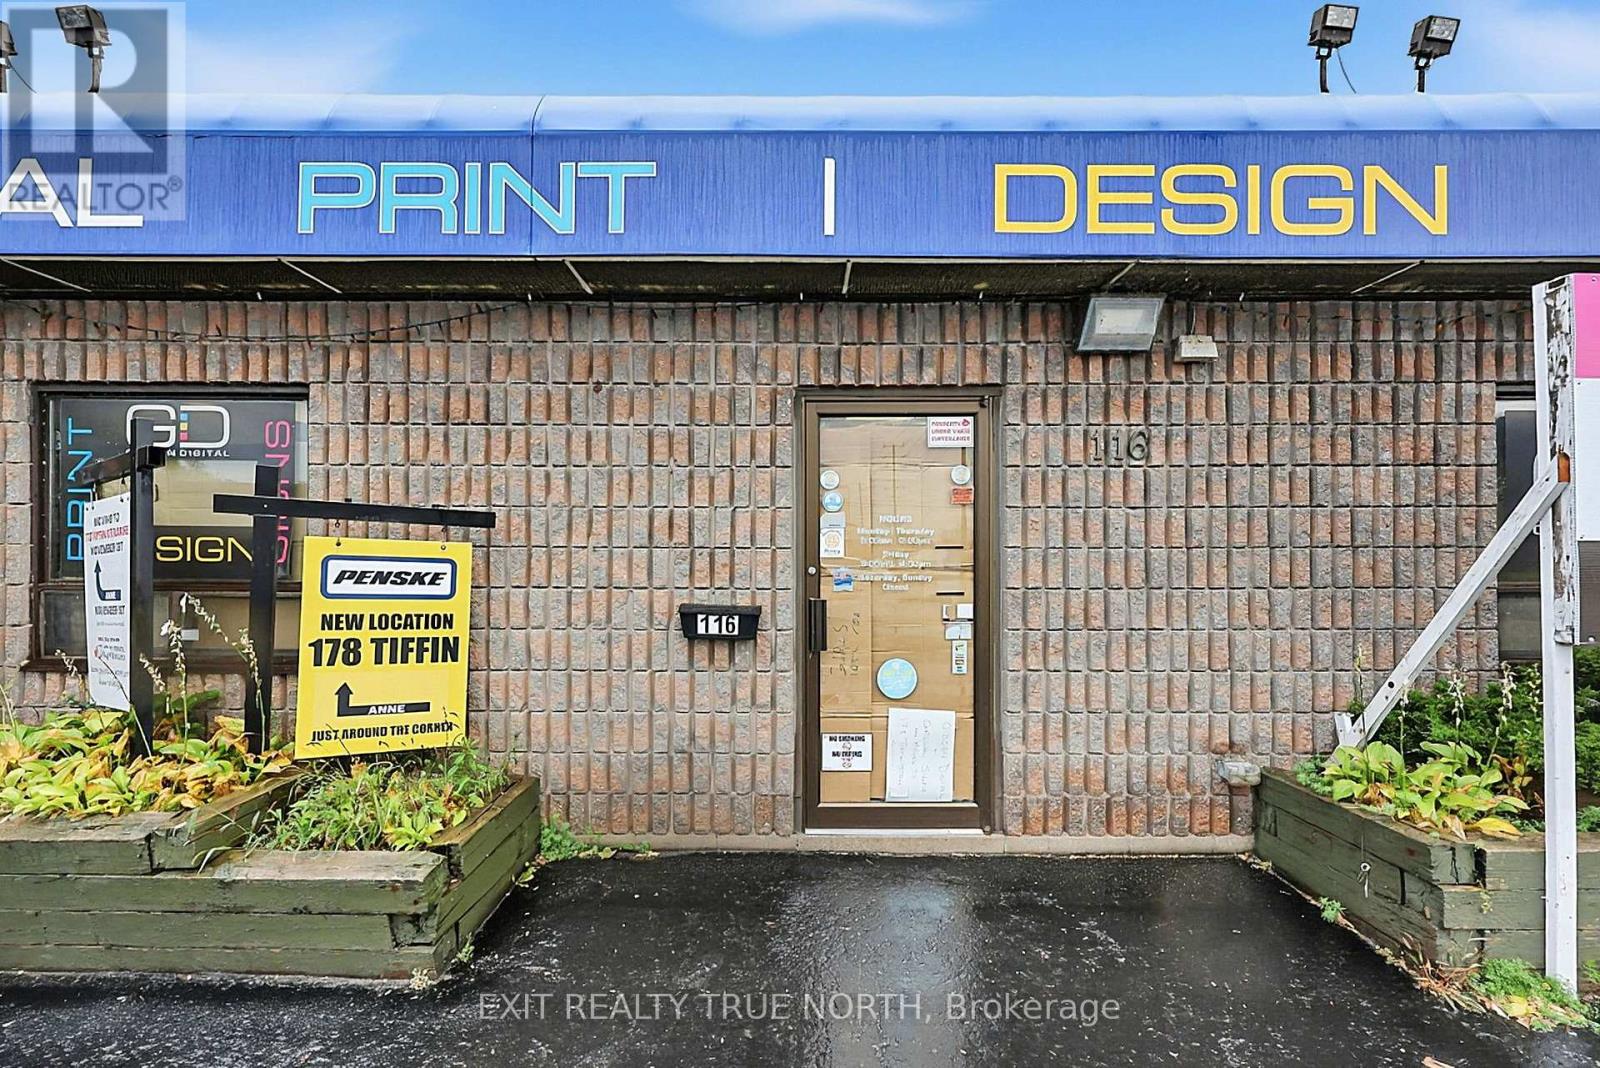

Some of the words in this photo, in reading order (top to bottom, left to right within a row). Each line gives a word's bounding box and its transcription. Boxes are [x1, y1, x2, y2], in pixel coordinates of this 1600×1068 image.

[297, 161, 656, 235] PRINT
[994, 164, 1449, 236] DESIGN
[179, 449, 231, 457] DIGITAL
[1091, 429, 1148, 461] 116
[333, 569, 447, 587] PENSKE
[320, 613, 364, 631] NEW
[368, 613, 454, 631] LOCATION
[700, 613, 736, 634] 116
[308, 638, 362, 667] 178
[370, 636, 460, 666] TIFFIN
[367, 704, 406, 715] ANNE
[312, 729, 339, 742] JUST
[341, 726, 388, 740] AROUND
[390, 724, 410, 737] THE
